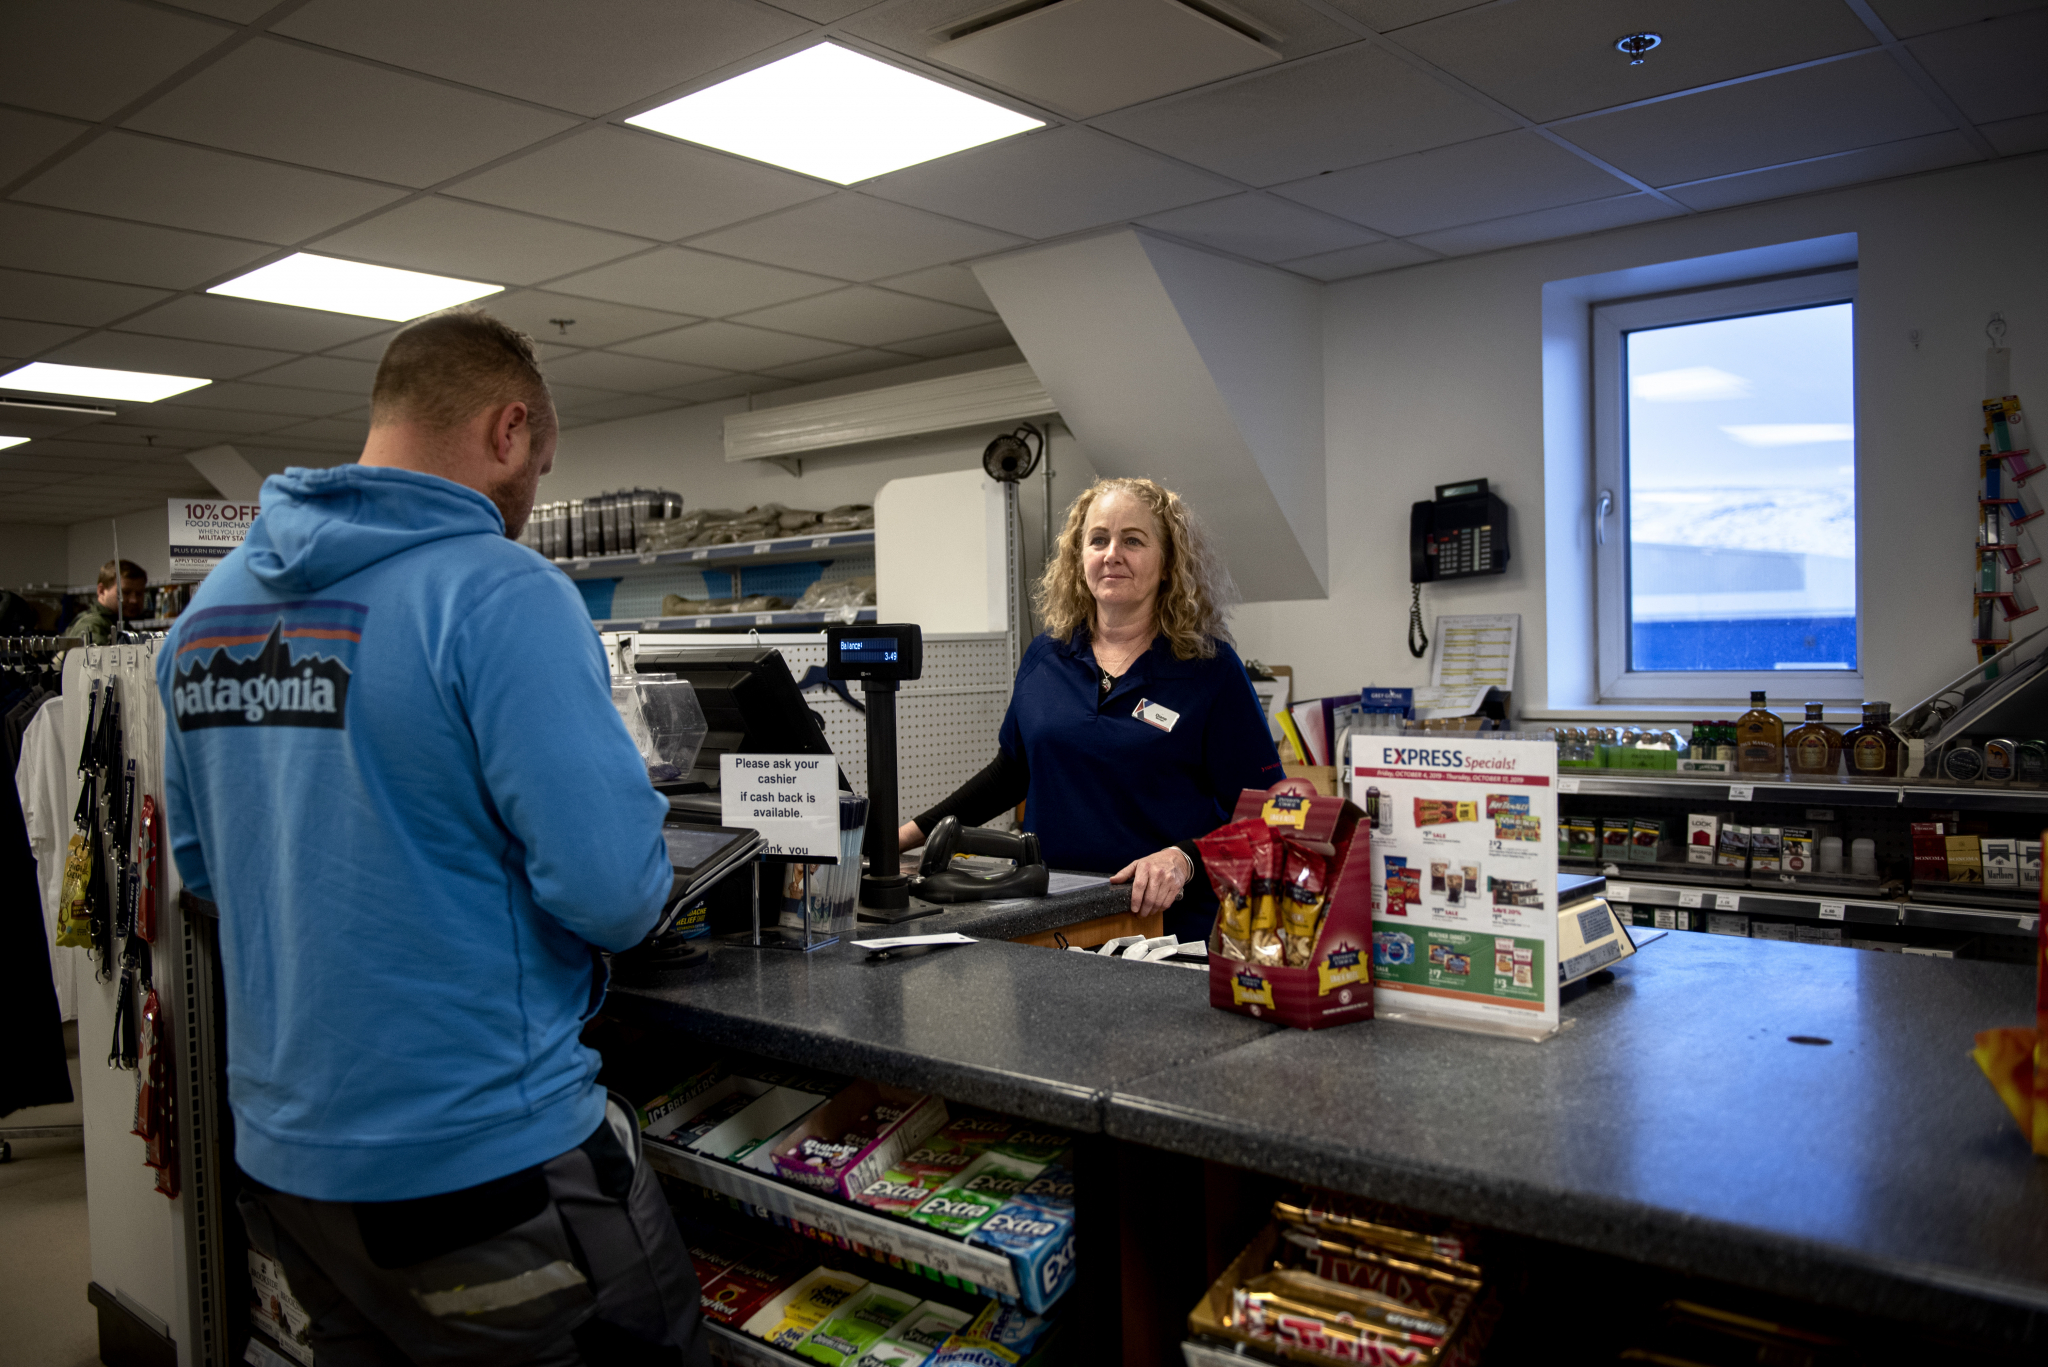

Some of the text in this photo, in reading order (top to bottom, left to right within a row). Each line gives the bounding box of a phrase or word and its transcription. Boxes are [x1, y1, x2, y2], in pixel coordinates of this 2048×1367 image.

[185, 504, 261, 521] 10% OFF
[186, 520, 210, 528] FOOD
[841, 641, 863, 650] Balance:
[884, 652, 897, 660] 3.49
[735, 758, 819, 771] Please ask your
[1384, 748, 1515, 770] EXPRESS Specials!
[758, 774, 796, 784] cashier
[1377, 770, 1394, 778] Friday,
[1395, 771, 1422, 779] OCTOBER
[1446, 773, 1471, 781] Thursday,
[1472, 774, 1501, 782] OCTOBER
[740, 792, 816, 803] if cash back is
[753, 808, 803, 818] available.
[760, 844, 782, 854] ank
[1988, 867, 2014, 879] Marlboro
[646, 1073, 716, 1124] ICE BREAKERS
[948, 1117, 1012, 1132] Extra
[1005, 1130, 1072, 1146] Extra
[803, 1140, 859, 1154] Bubble
[906, 1148, 972, 1166] Extra
[862, 1180, 930, 1200] Extra
[919, 1198, 990, 1218] Extra
[980, 1214, 1056, 1236] Extra
[250, 1268, 278, 1290] BROOKSIDE
[935, 1352, 1007, 1367] mentos
